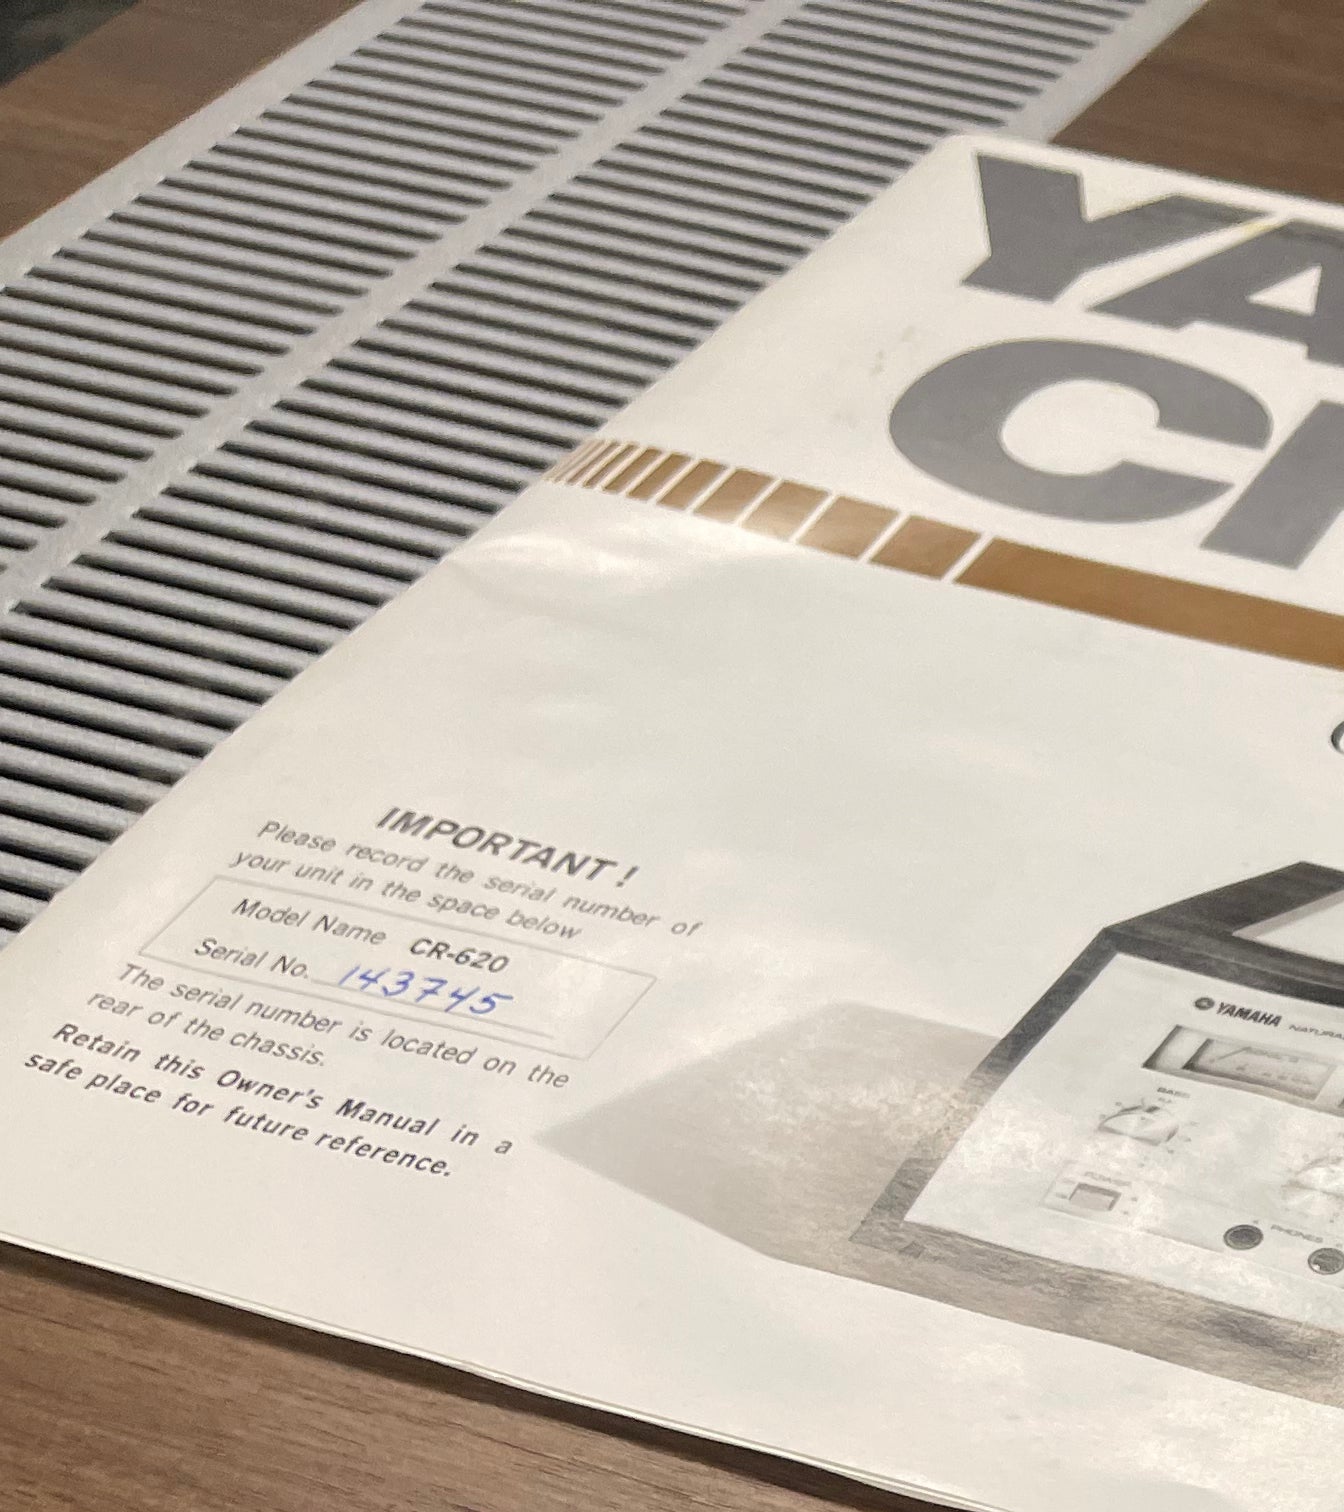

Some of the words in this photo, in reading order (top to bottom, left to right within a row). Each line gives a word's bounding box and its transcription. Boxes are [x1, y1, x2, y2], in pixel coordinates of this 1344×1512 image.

[257, 820, 337, 852] Please
[345, 842, 430, 873] record
[434, 861, 475, 884] the
[483, 874, 556, 903] serial
[562, 896, 661, 928] number
[670, 921, 703, 937] of
[375, 806, 618, 881] IMPORTANT
[615, 865, 639, 888] !
[228, 851, 292, 874] your
[294, 864, 344, 886] unit
[348, 872, 374, 892] in
[380, 880, 422, 903] the
[427, 892, 500, 920] space
[505, 908, 583, 940] below
[231, 897, 311, 928] Model
[311, 914, 387, 945] Name
[409, 937, 511, 974] CR-620
[193, 936, 269, 968] Serial
[269, 955, 309, 980] No.
[337, 963, 514, 1015] 143745
[87, 991, 144, 1018] rear
[147, 1010, 183, 1028] of
[182, 1016, 225, 1042] the
[229, 1031, 325, 1067] chassis.
[118, 961, 164, 991] The
[170, 982, 244, 1012] serial
[244, 1000, 343, 1034] number
[348, 1019, 373, 1043] is
[381, 1028, 478, 1065] located
[482, 1055, 517, 1076] on
[527, 1062, 570, 1090] the
[1214, 1000, 1284, 1029] YAMAHA
[24, 1052, 83, 1081] safe
[84, 1072, 162, 1104] place
[171, 1091, 214, 1116] for
[223, 1105, 310, 1142] future
[314, 1130, 452, 1178] reference.
[52, 1022, 142, 1063] Retain
[153, 1053, 206, 1080] this
[216, 1068, 324, 1111] Owner's
[334, 1097, 441, 1137] Manual
[449, 1123, 480, 1148] in
[493, 1139, 514, 1155] a
